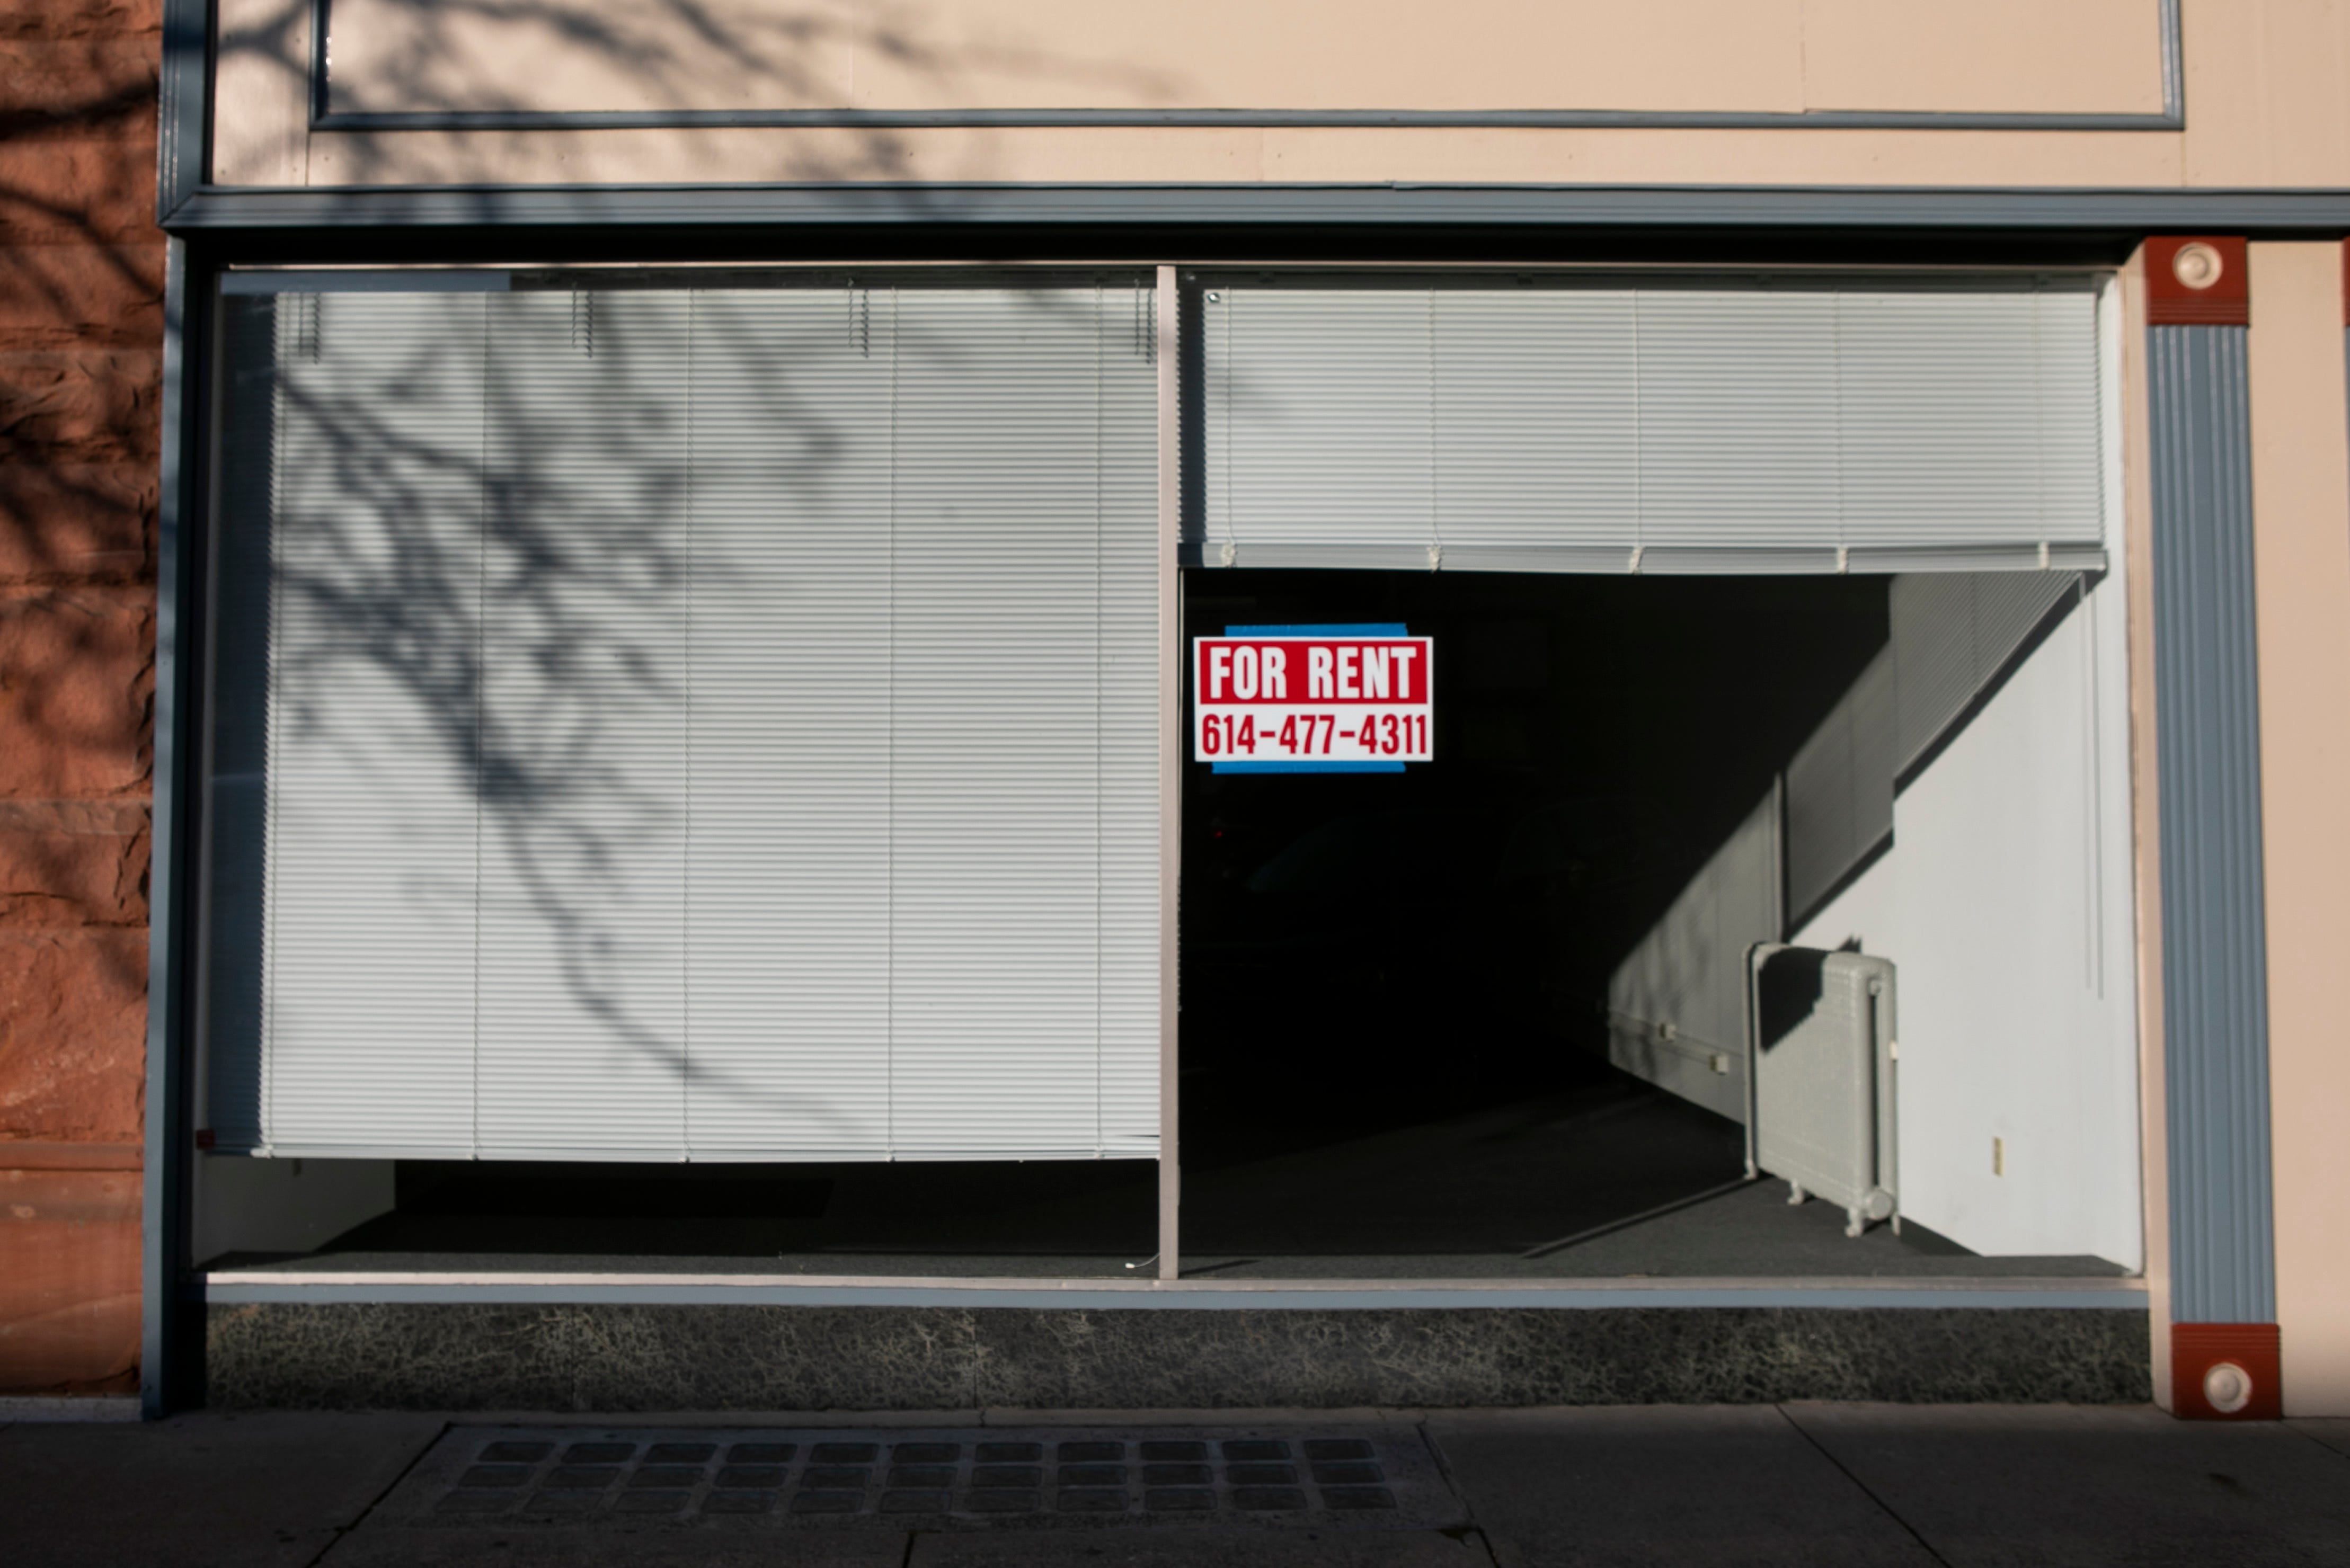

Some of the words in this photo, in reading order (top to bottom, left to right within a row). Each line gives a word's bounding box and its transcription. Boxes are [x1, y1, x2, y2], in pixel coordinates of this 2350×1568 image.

[1210, 646, 1287, 700] FOR
[1308, 646, 1416, 699] RENT
[1202, 714, 1426, 755] 614-477-4311
